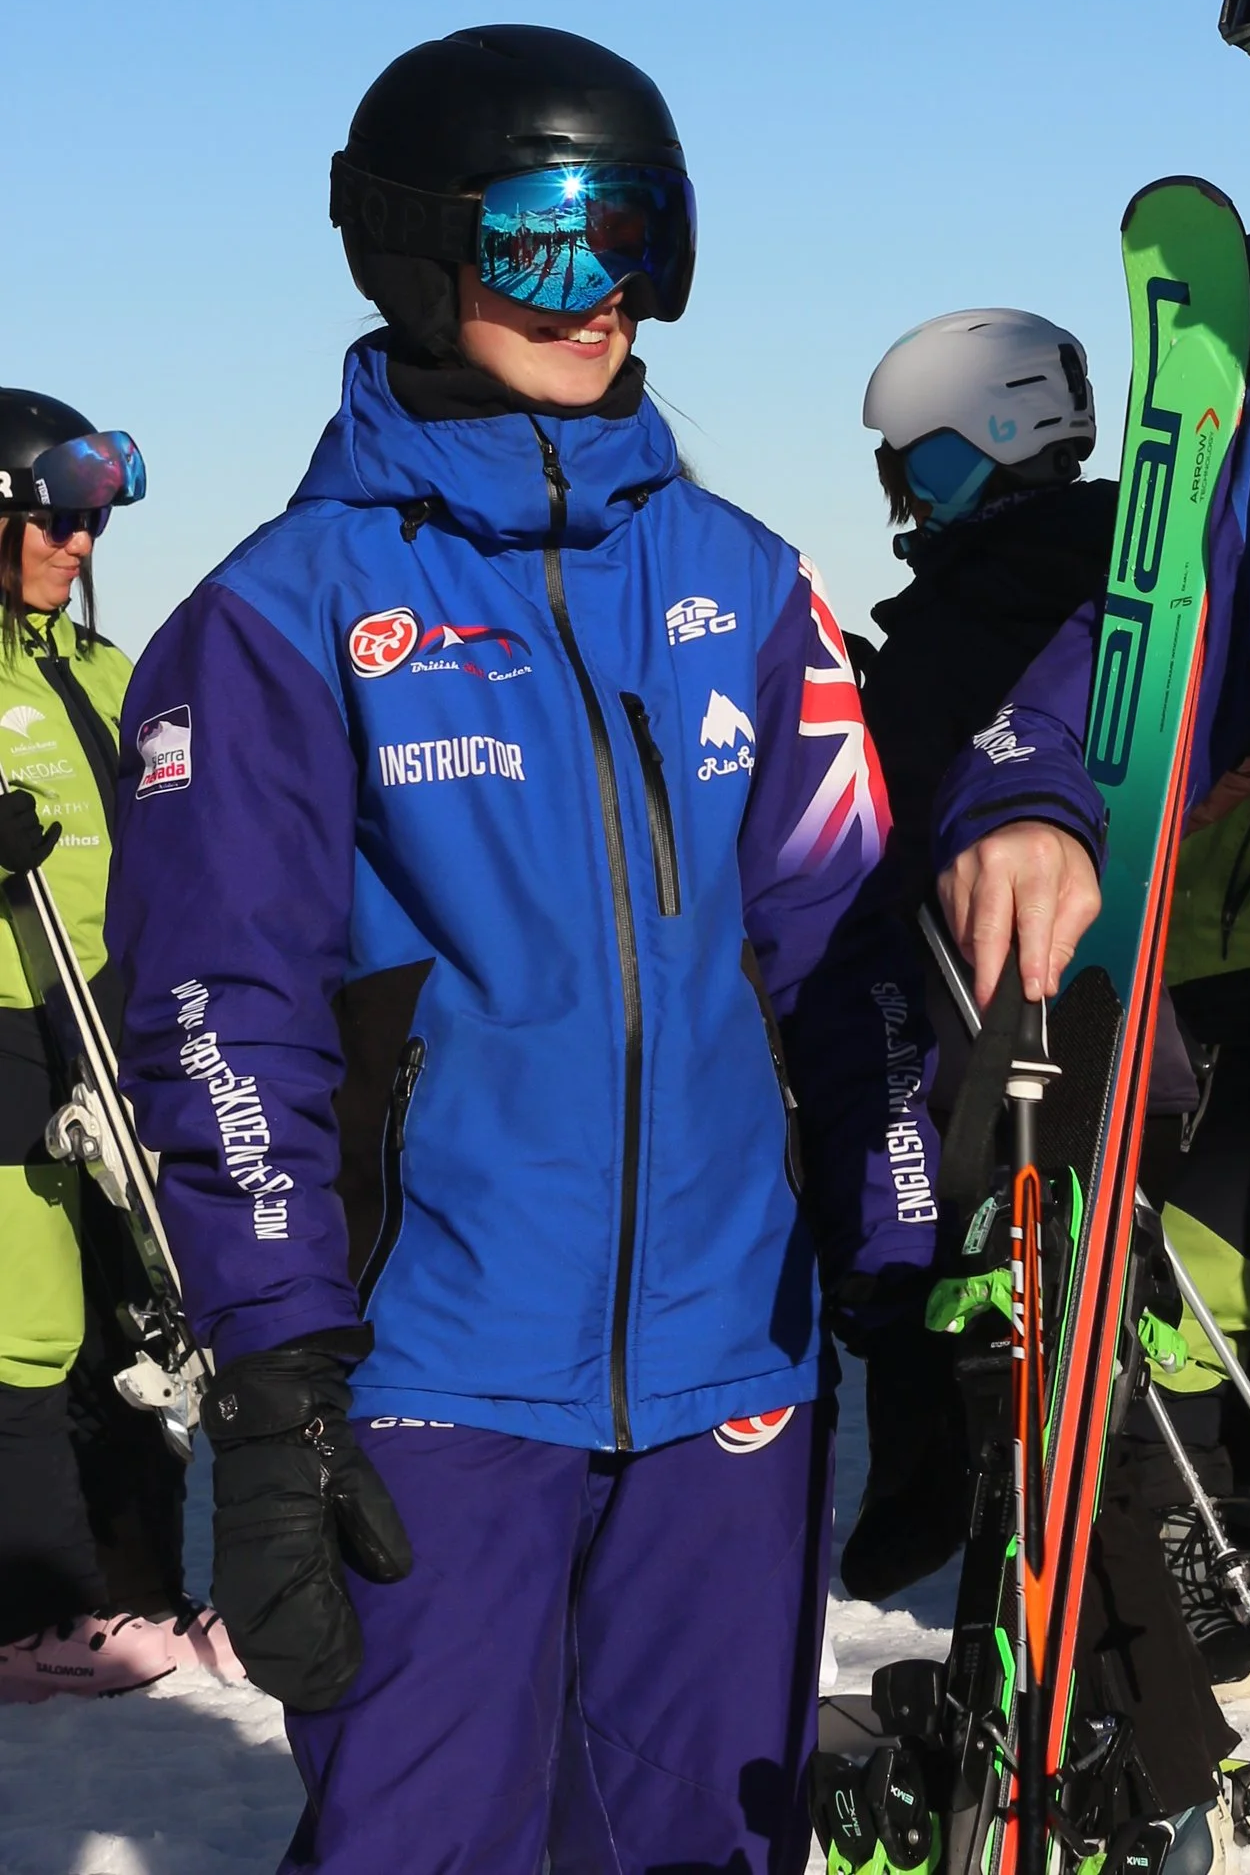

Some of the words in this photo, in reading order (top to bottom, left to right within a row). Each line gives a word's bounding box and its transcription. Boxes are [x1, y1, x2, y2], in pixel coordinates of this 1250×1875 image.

[1190, 433, 1207, 504] ARROW
[1200, 431, 1214, 501] TECHNOLOGY
[1087, 276, 1191, 788] elan
[667, 611, 737, 646] SG
[410, 660, 460, 673] British
[487, 665, 533, 681] Center
[11, 759, 74, 783] MEDAC
[378, 735, 526, 787] INSTRUCTOR
[697, 757, 739, 782] Rio
[737, 745, 756, 777] Sp
[41, 801, 90, 816] ARTHY
[58, 834, 100, 847] nthas
[870, 981, 923, 1114] INSTUCTORS
[885, 1120, 939, 1224] ENGLISH
[1126, 1855, 1149, 1867] EMX
